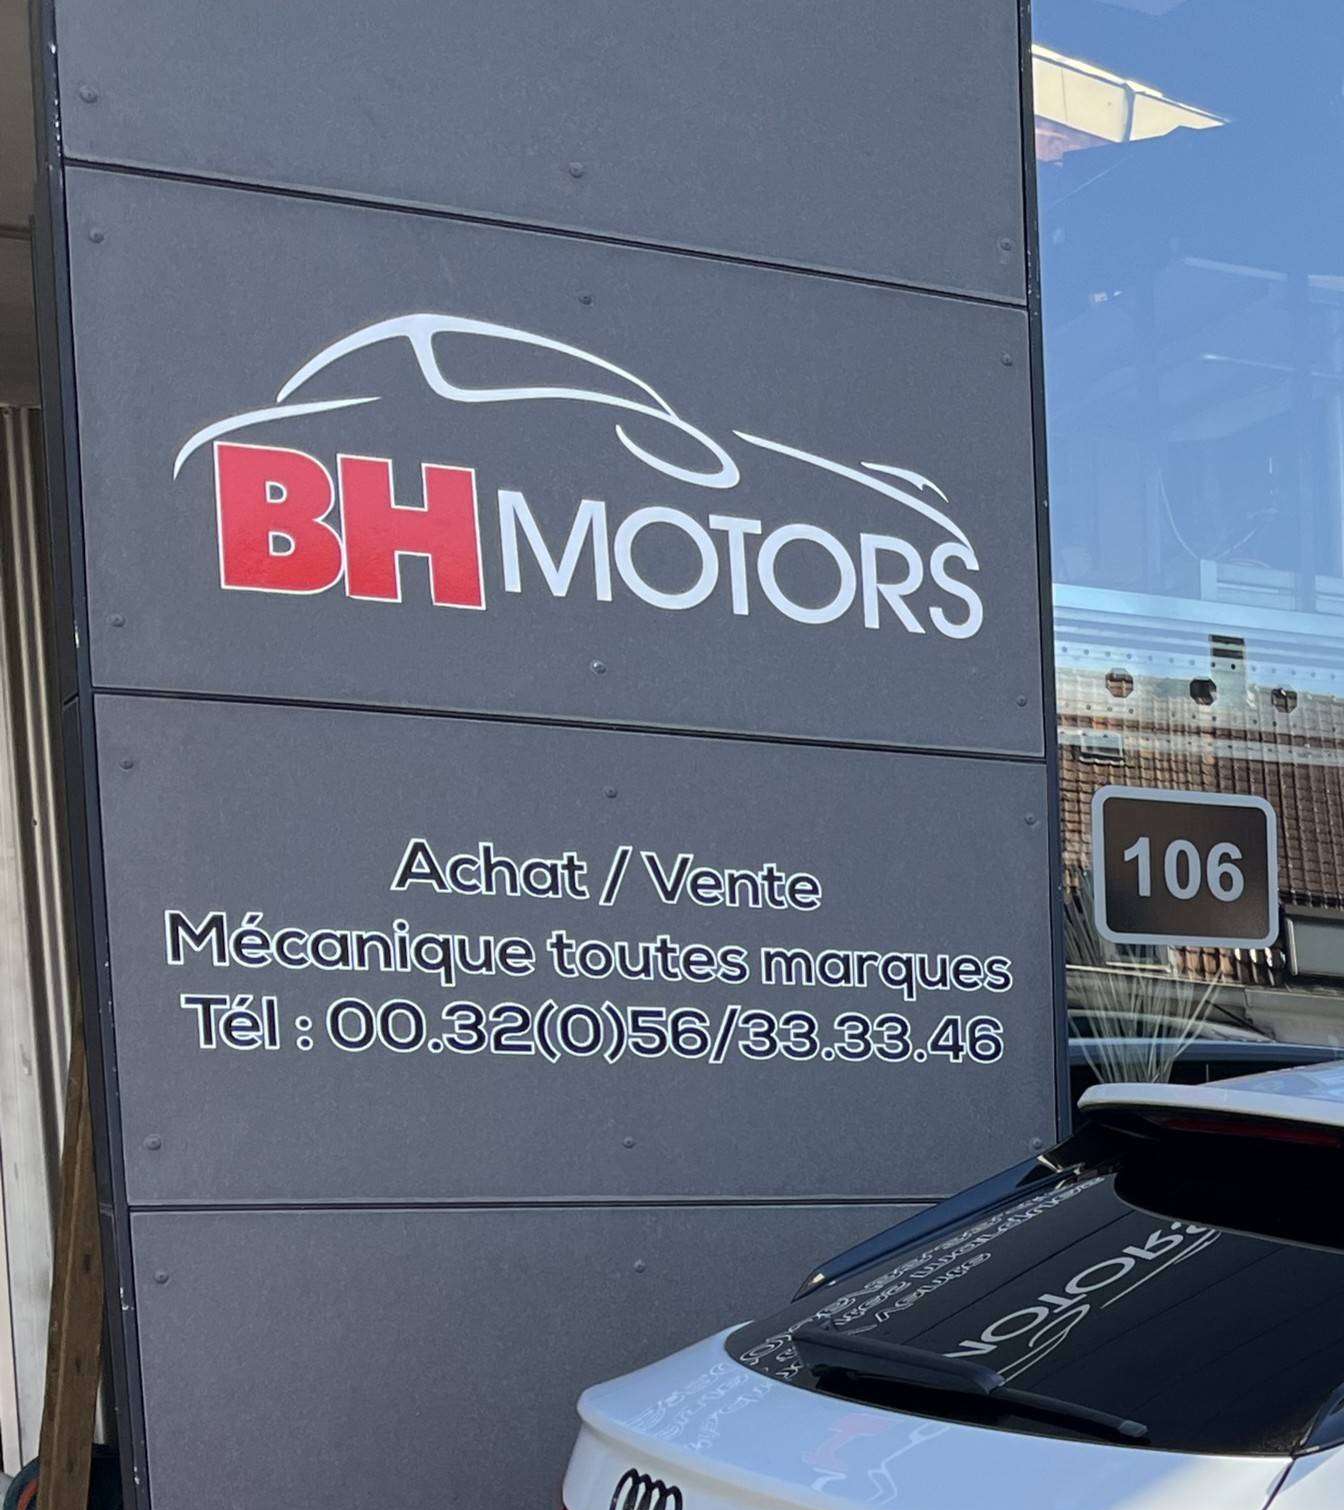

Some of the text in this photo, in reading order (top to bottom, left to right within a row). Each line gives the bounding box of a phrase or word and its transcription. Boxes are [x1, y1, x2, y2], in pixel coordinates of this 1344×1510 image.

[213, 440, 983, 640] BH MOTORS
[389, 837, 823, 912] Achat / Vente
[1123, 837, 1244, 902] 106
[164, 909, 1014, 1002] Mécanique toutes marques
[179, 993, 281, 1051] Tél
[325, 995, 1005, 1065] 00.32(0)56/33.33.46
